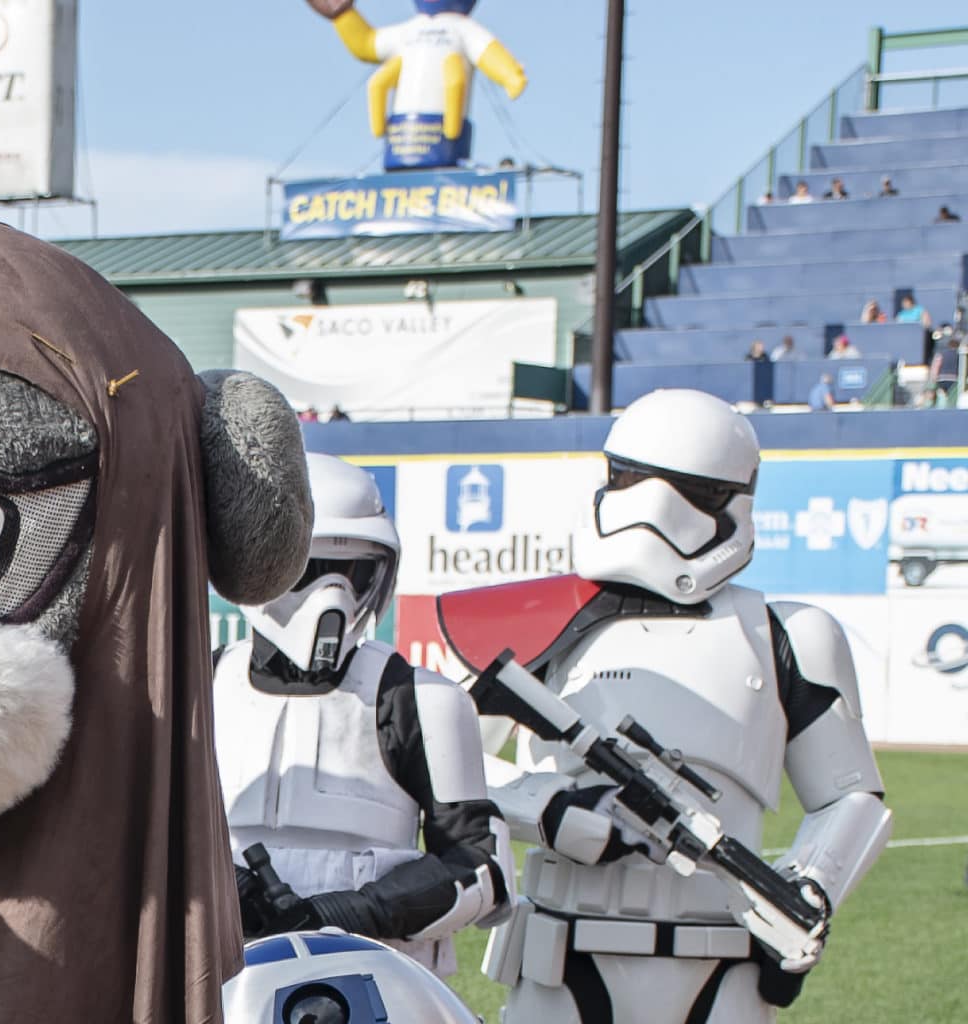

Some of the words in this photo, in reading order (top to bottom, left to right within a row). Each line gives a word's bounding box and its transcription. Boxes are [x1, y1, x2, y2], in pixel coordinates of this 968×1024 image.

[289, 189, 377, 223] CATCH
[380, 186, 436, 219] THE
[318, 318, 373, 337] SACO
[382, 315, 453, 334] VALLEY
